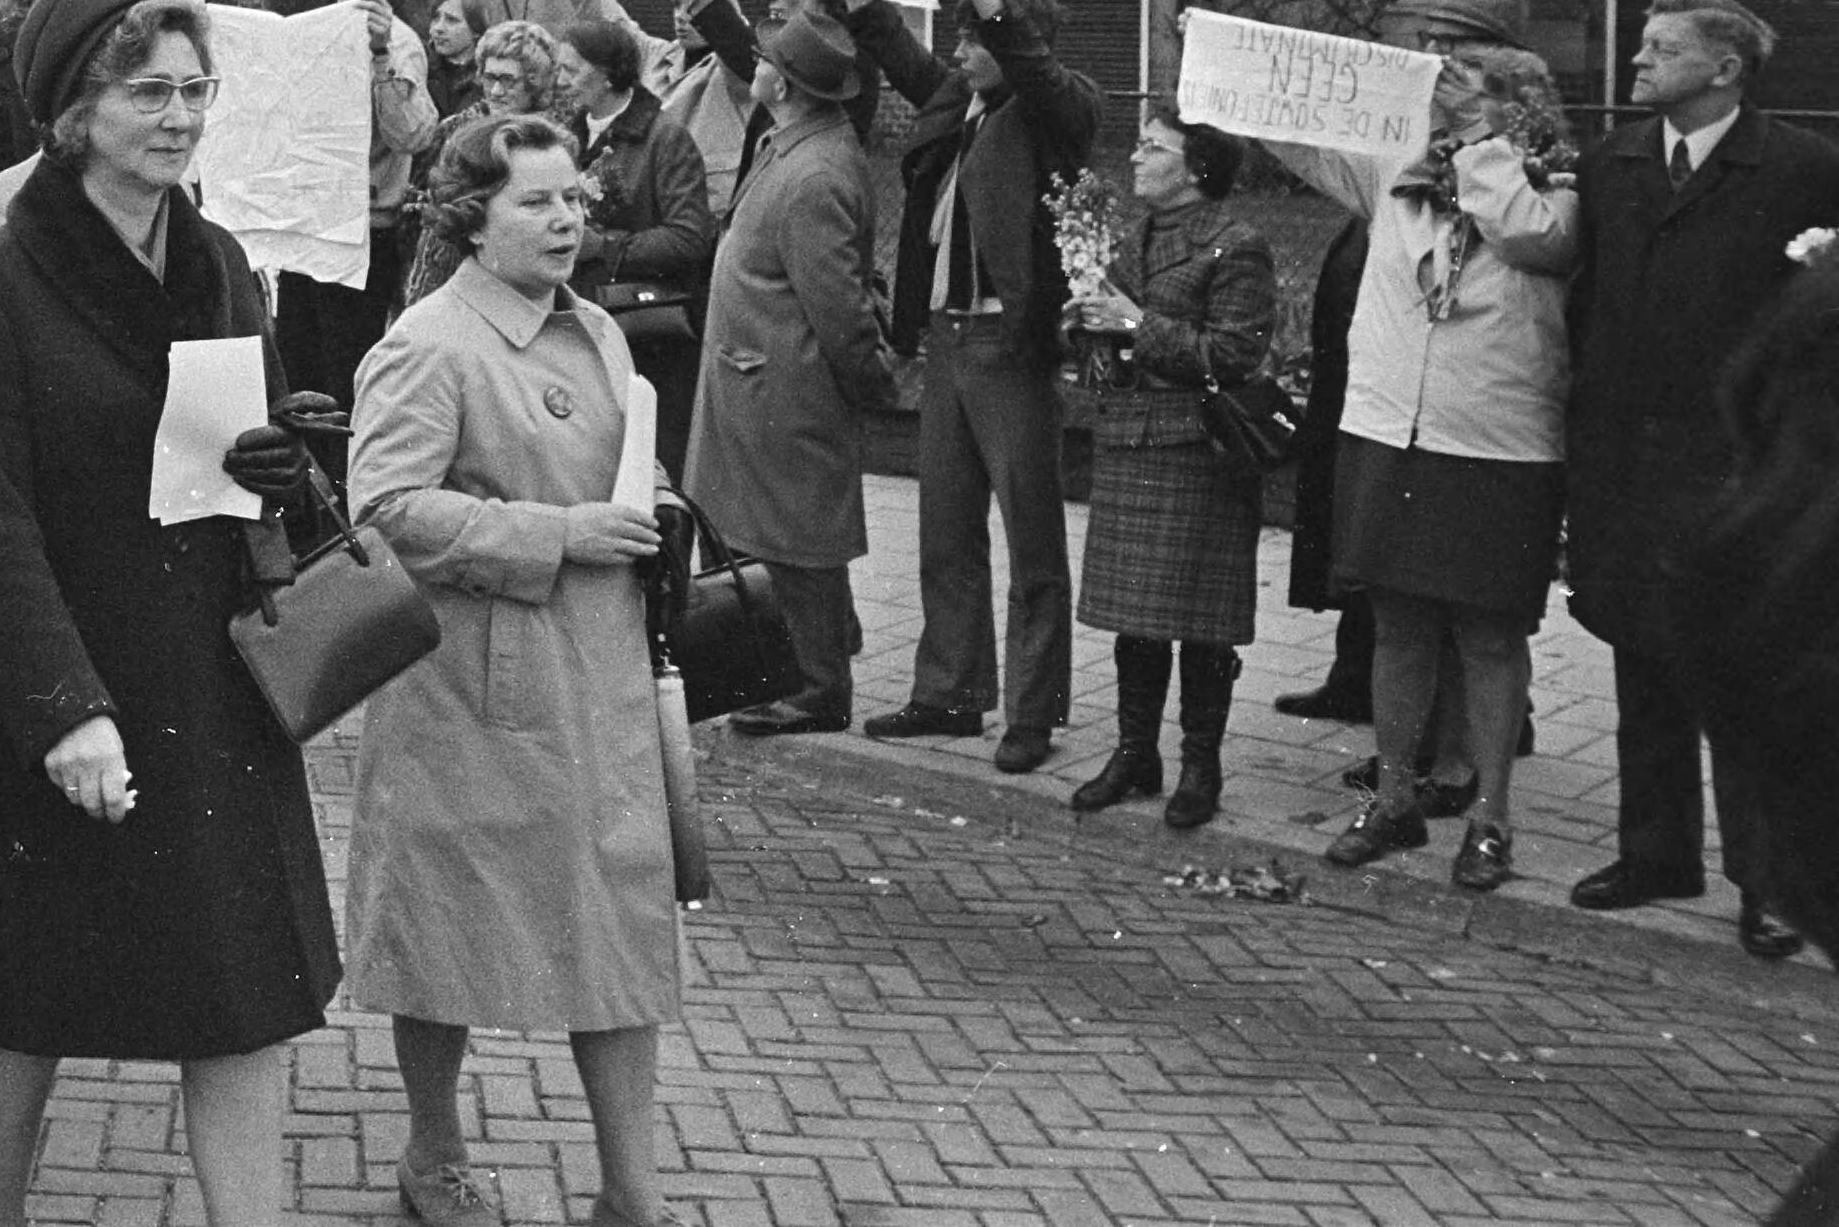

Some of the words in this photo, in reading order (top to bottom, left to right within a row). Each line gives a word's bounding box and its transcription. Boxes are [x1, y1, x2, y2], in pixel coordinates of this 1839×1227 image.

[1268, 53, 1358, 105] GEEN
[1337, 108, 1371, 138] DE
[1383, 115, 1410, 144] IN
